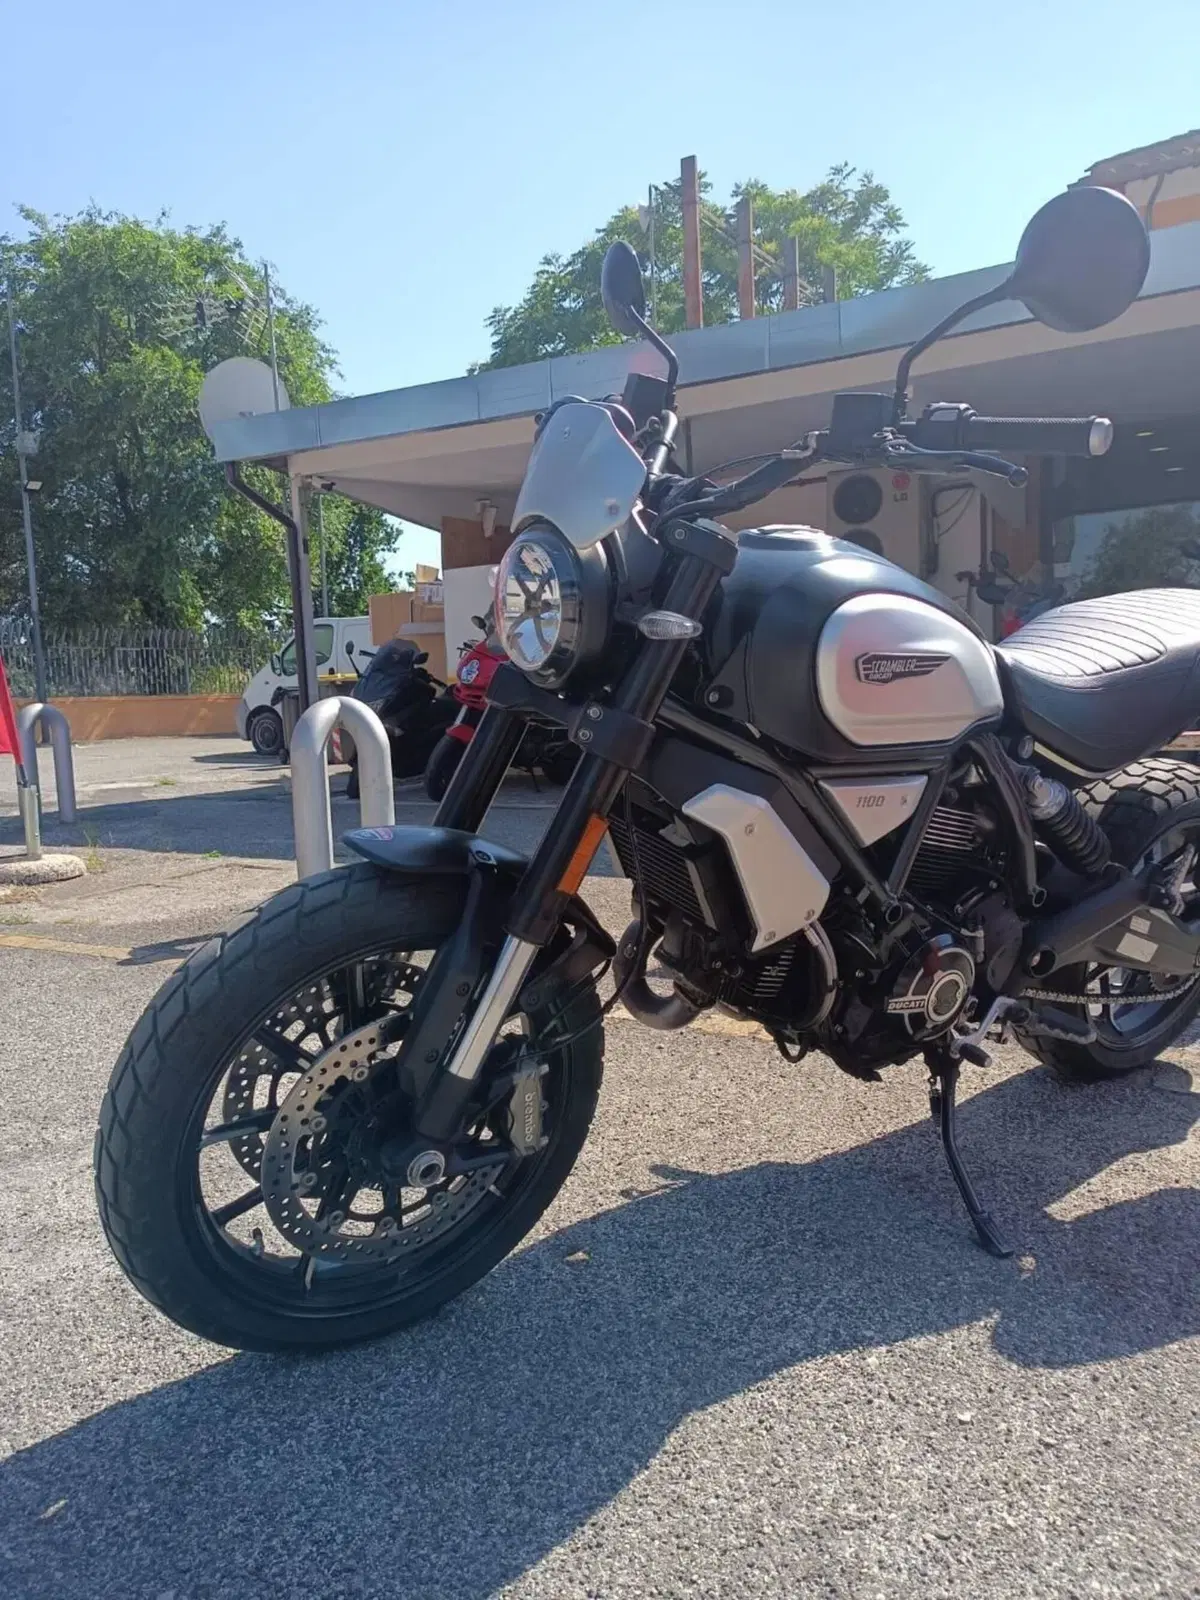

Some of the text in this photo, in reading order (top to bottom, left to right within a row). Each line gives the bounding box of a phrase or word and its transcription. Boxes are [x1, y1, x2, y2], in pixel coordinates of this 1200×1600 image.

[871, 659, 916, 672] SCRAMBLER
[856, 795, 885, 807] 1100
[887, 1000, 925, 1010] DUCATI
[524, 1092, 535, 1142] brembo
